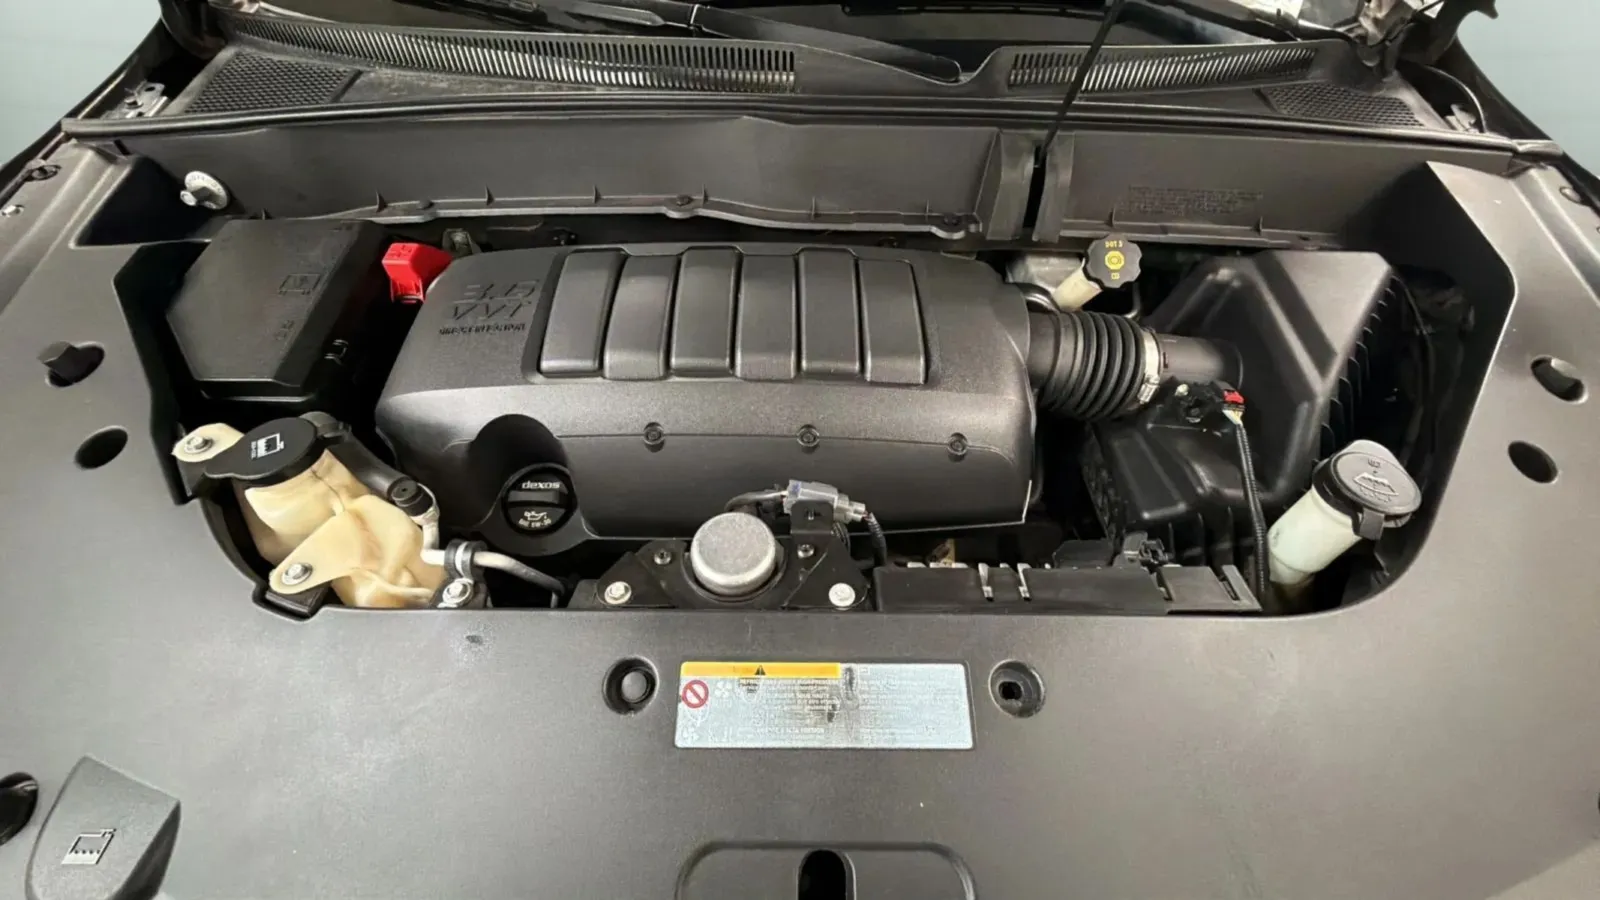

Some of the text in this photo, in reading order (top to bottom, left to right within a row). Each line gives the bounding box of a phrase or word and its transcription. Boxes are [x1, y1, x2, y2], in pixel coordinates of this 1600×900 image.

[453, 280, 539, 304] 3.6
[450, 301, 533, 321] VVT
[521, 480, 561, 490] dexos
